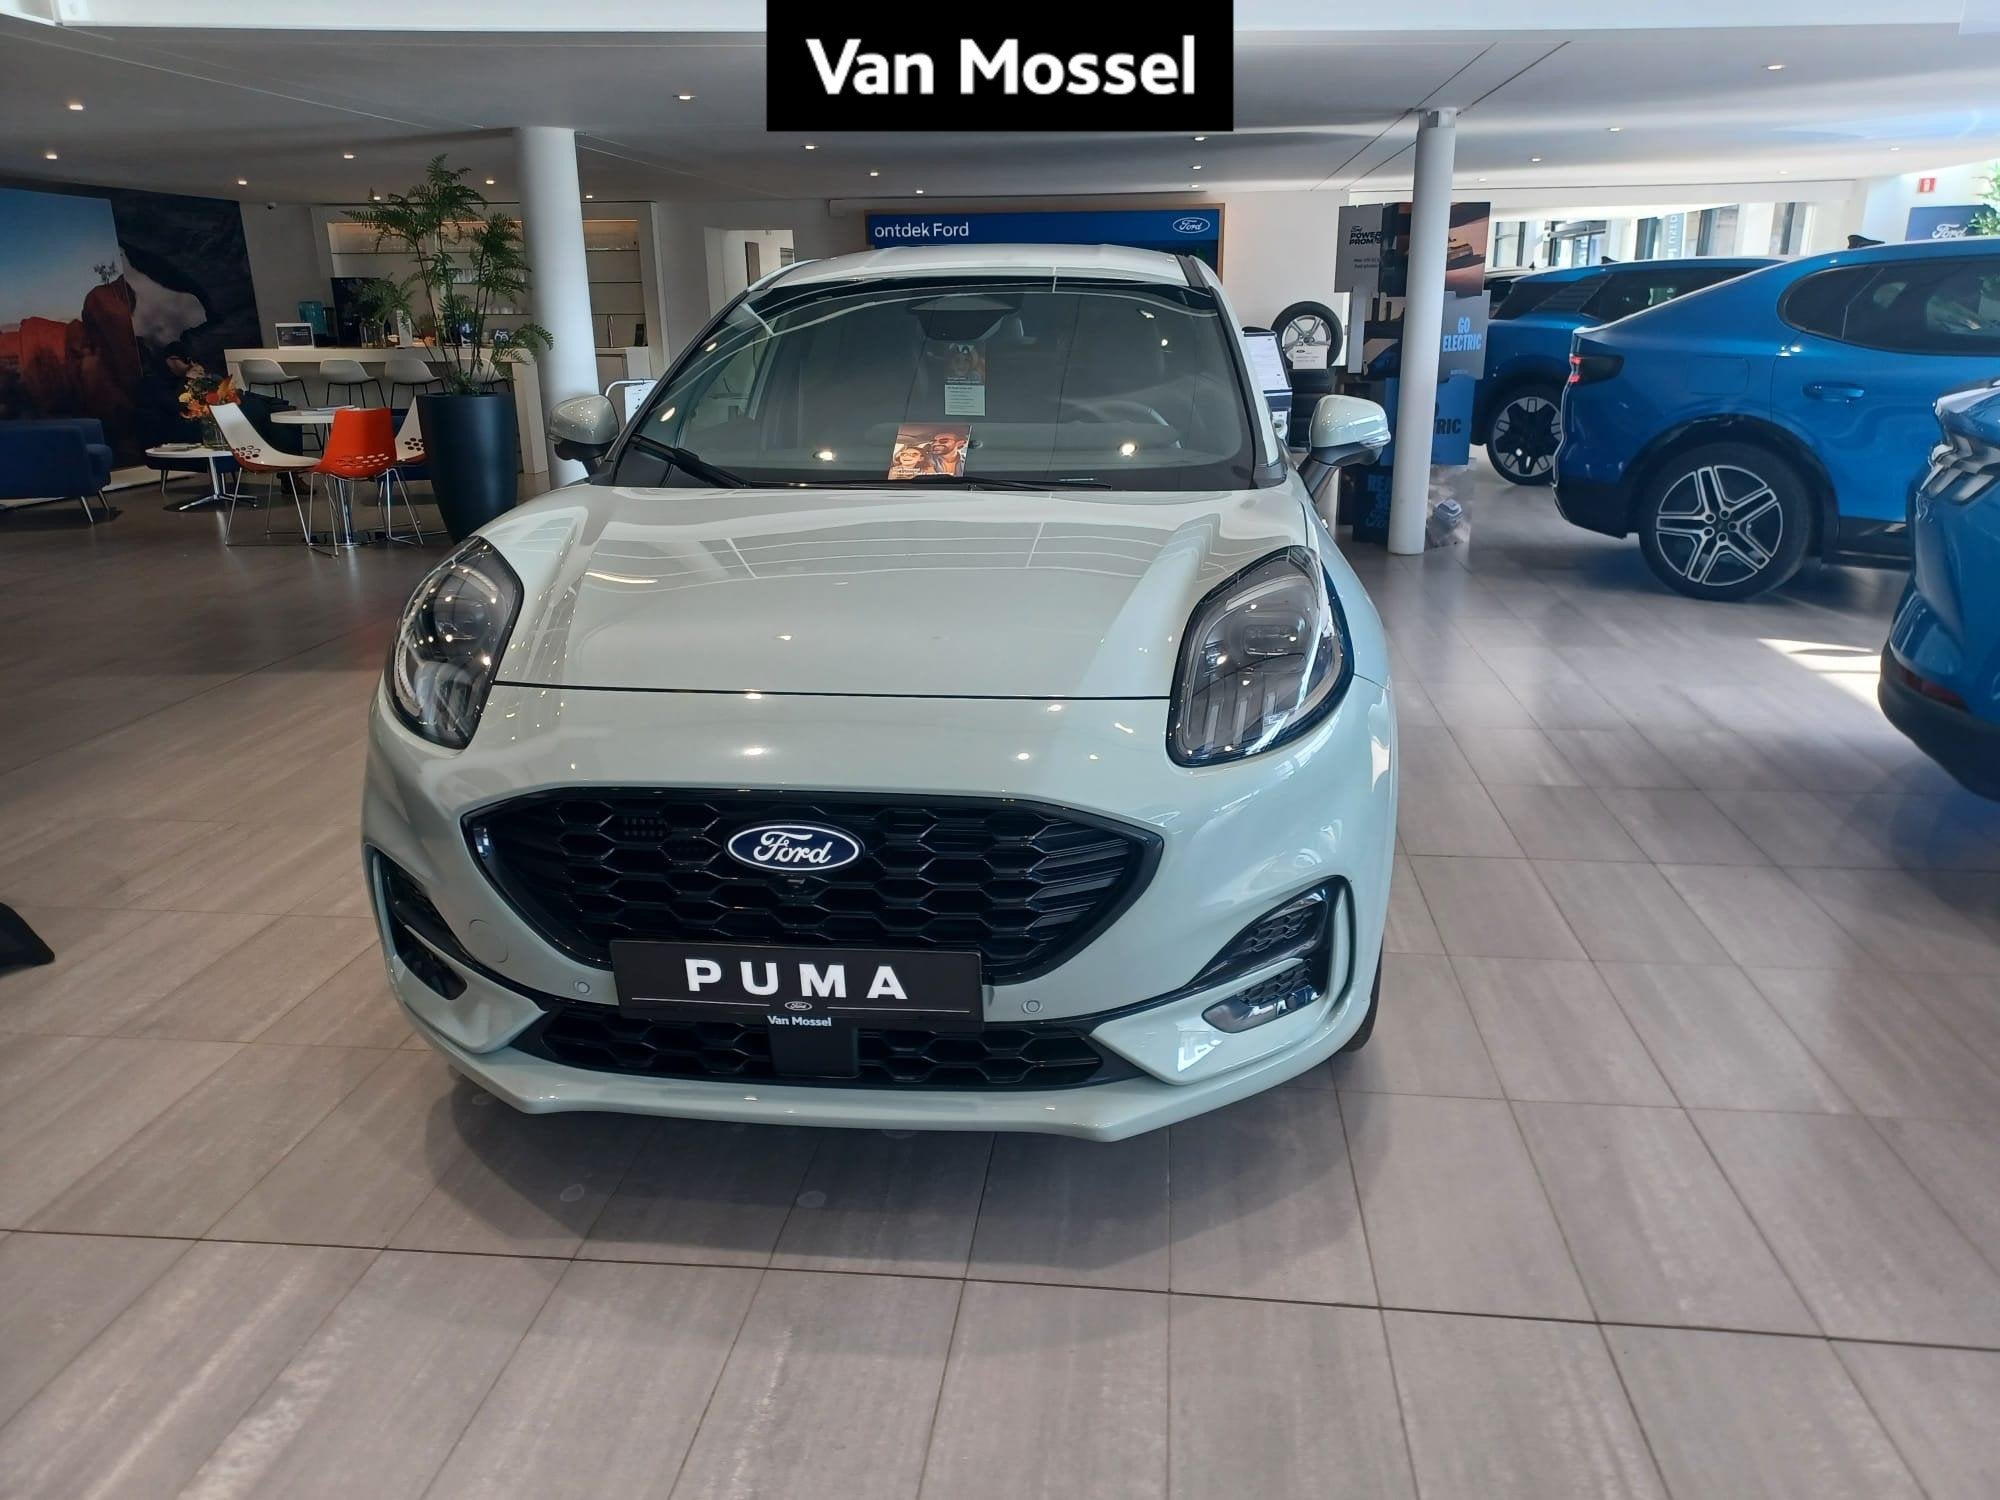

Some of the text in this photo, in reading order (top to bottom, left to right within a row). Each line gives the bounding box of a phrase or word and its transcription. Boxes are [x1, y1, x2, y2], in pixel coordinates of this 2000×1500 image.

[874, 221, 969, 238] ontdek Ford
[1457, 316, 1471, 334] GO
[1442, 334, 1482, 352] ELECTRIC
[753, 831, 833, 864] Ford
[685, 958, 908, 1000] PUMA
[767, 1015, 832, 1027] Van Mossel
